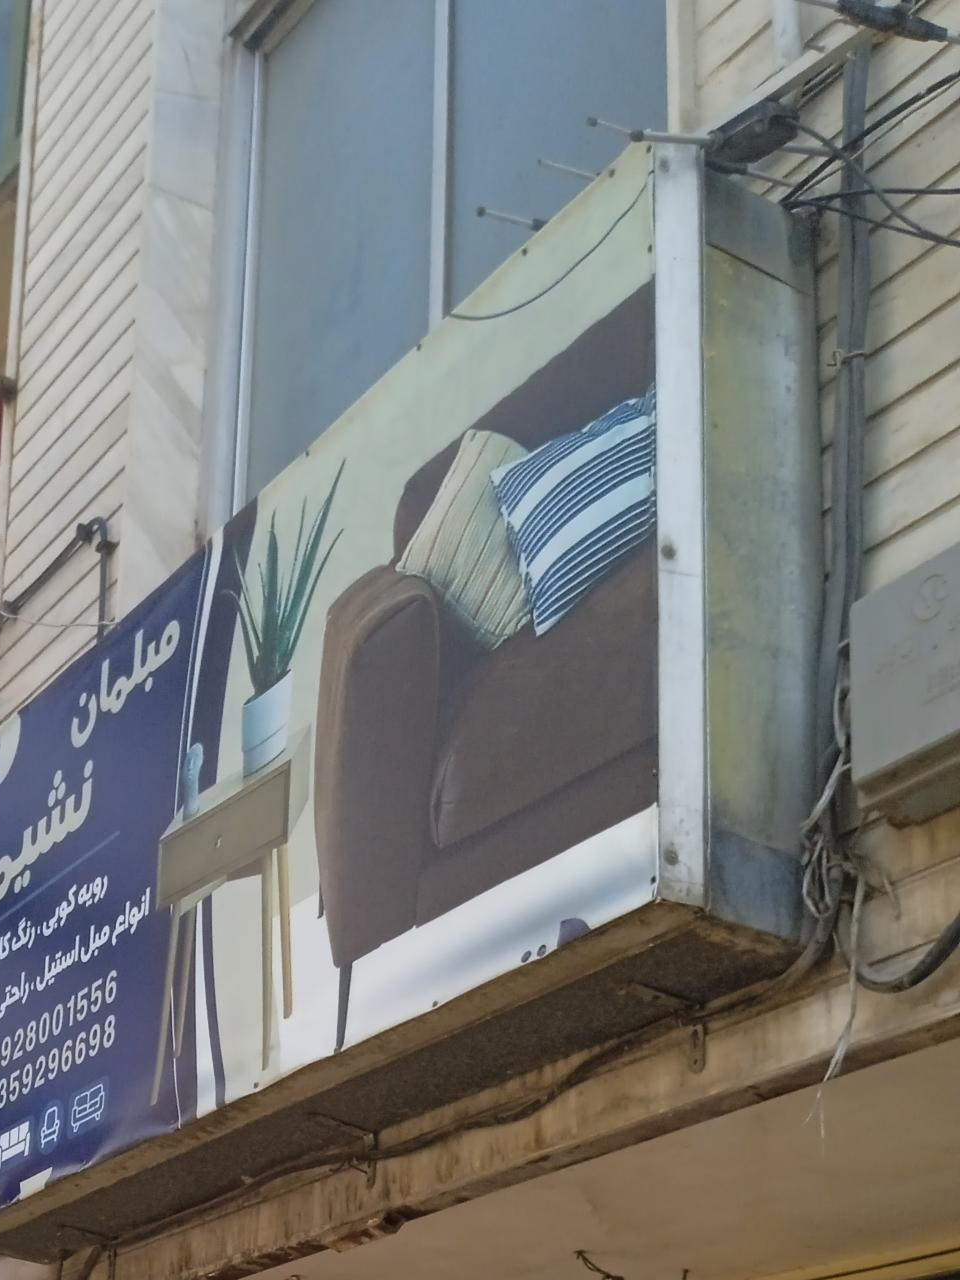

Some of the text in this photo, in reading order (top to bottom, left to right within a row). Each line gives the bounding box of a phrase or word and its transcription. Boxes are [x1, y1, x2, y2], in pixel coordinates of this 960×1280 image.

[70, 619, 181, 749] مبلمان
[77, 874, 108, 908] رویه
[11, 916, 37, 951] رنگ
[111, 886, 151, 947] انواع
[80, 924, 111, 964] مبل
